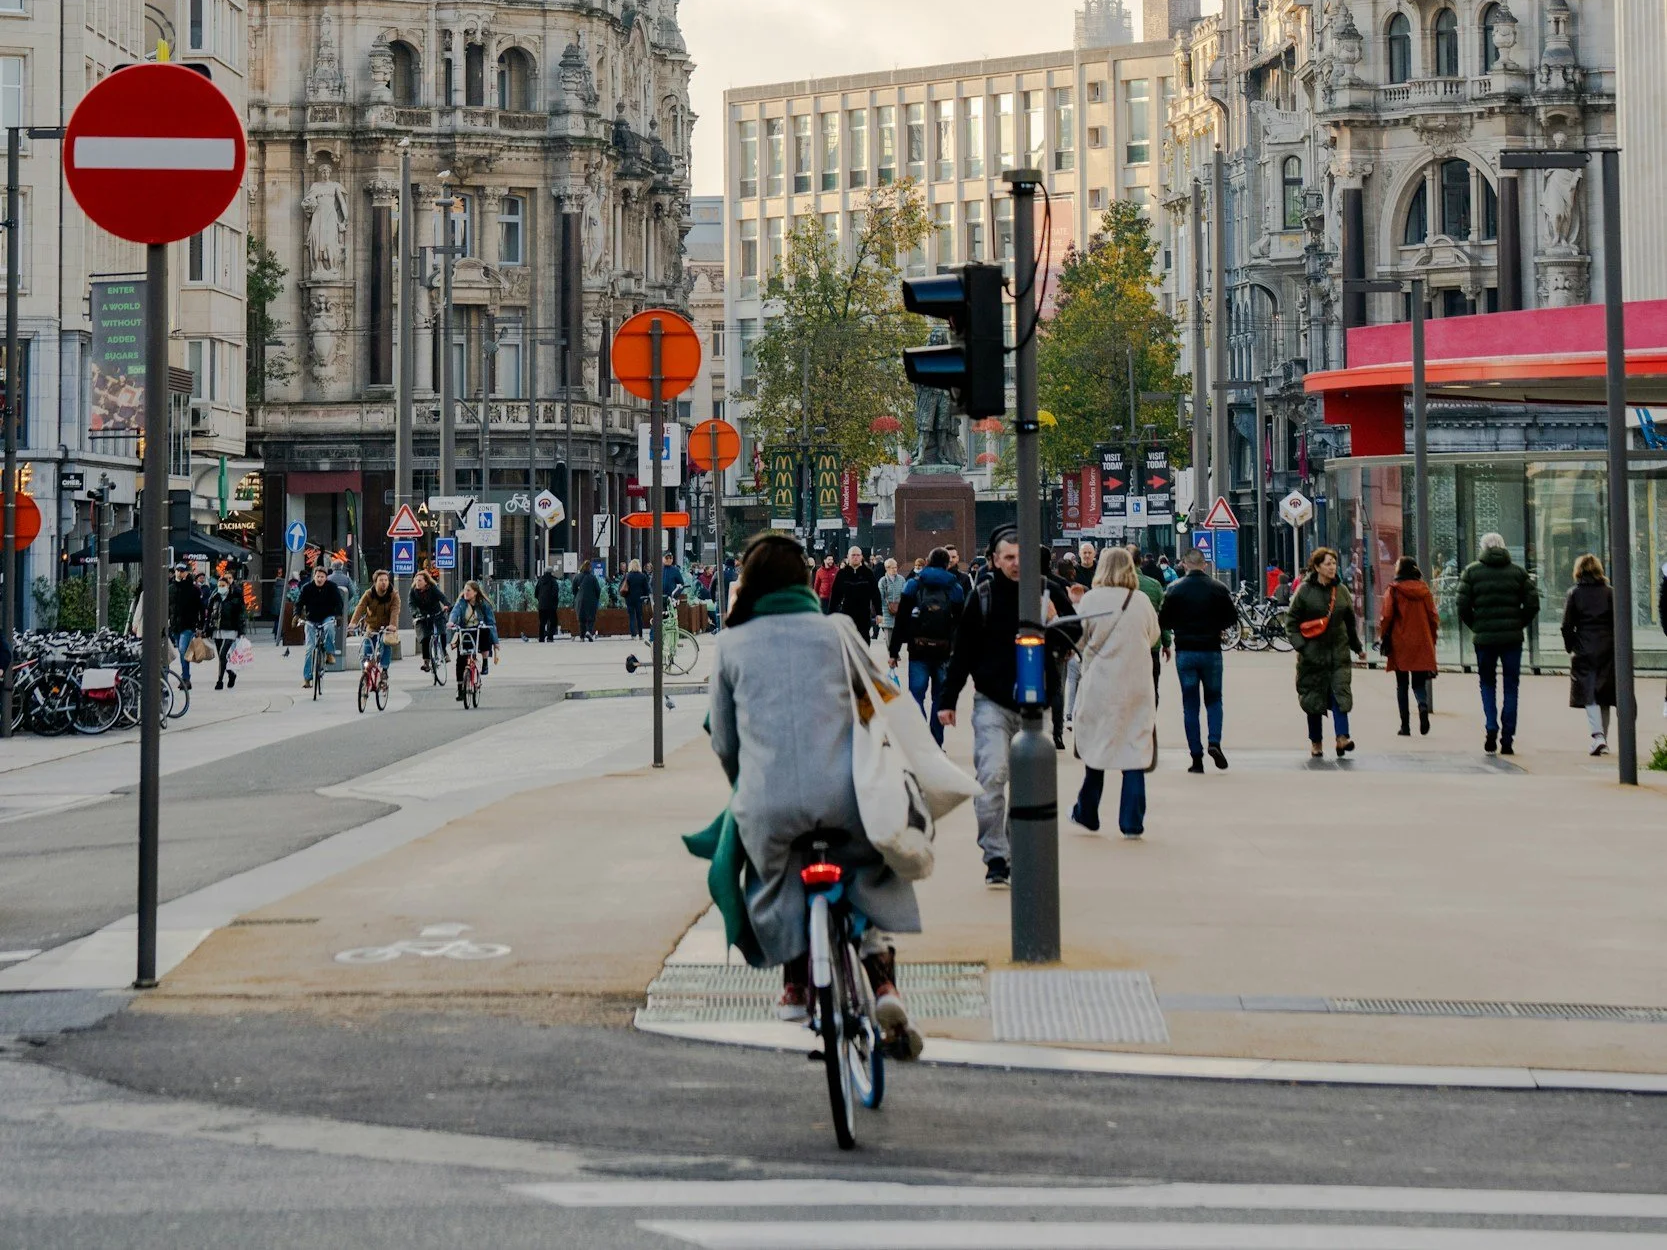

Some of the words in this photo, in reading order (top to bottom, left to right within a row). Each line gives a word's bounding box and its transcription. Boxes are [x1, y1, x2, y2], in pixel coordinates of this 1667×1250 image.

[109, 302, 141, 310] WORLD
[101, 319, 142, 327] WITHOUT
[104, 352, 139, 360] SUGARS
[1104, 453, 1121, 462] VISIT
[1148, 452, 1165, 460] VISIT
[1102, 462, 1123, 470] TODAY
[1146, 460, 1167, 469] TODAY
[842, 486, 850, 511] Vanden
[219, 522, 256, 530] EXCHANGE
